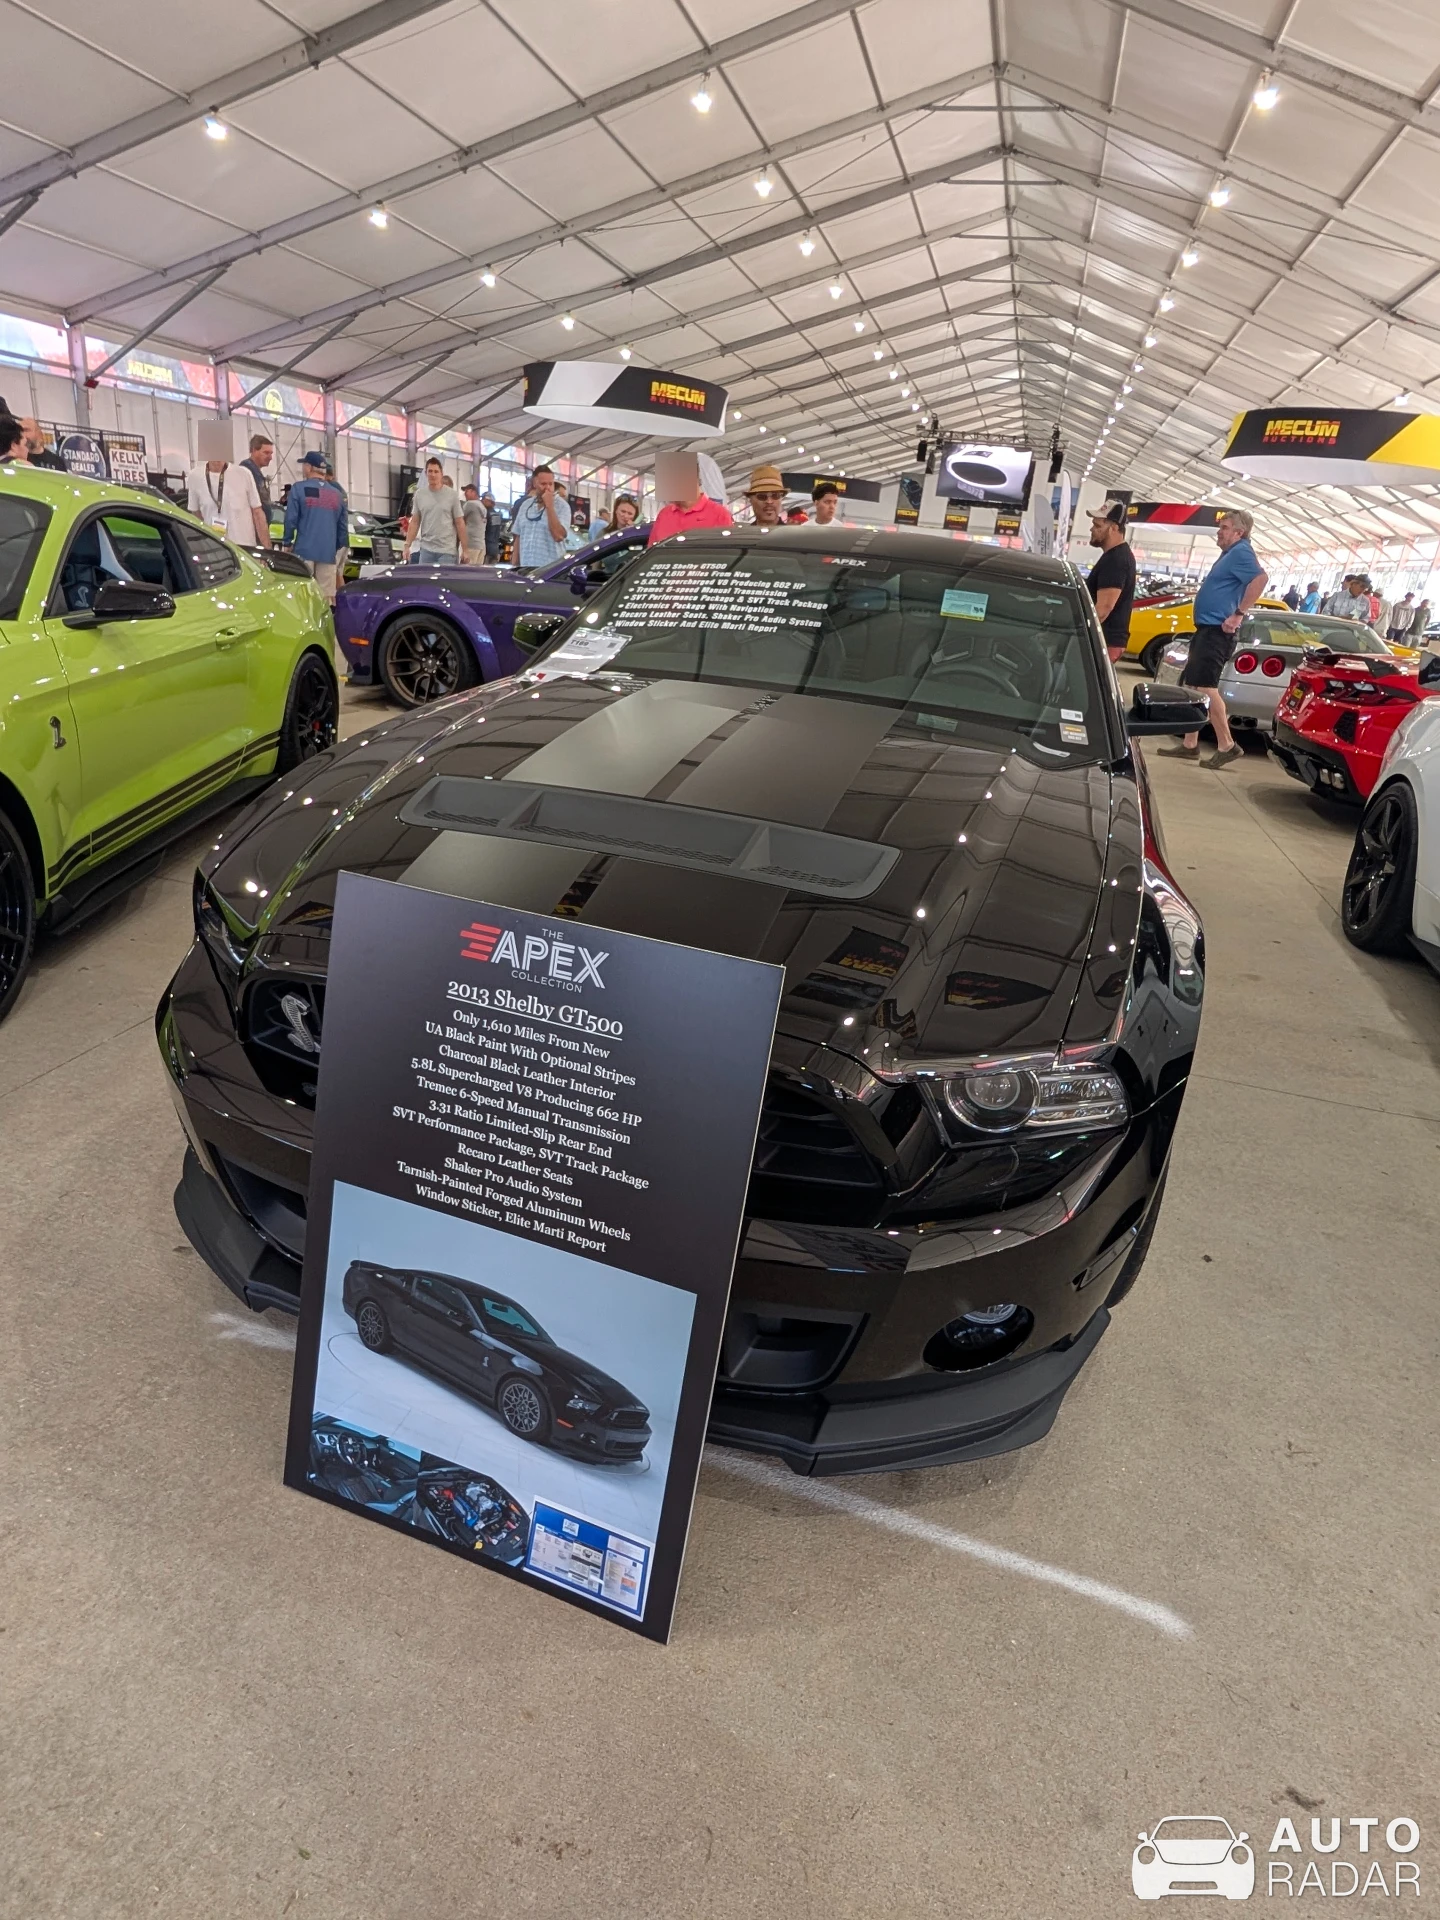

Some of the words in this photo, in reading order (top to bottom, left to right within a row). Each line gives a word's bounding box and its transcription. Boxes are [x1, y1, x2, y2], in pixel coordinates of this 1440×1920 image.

[651, 381, 705, 405] MECUM
[650, 396, 704, 411] AUCTIONS
[1265, 420, 1340, 436] MECUM
[1263, 436, 1336, 444] AUCTIONS
[64, 449, 100, 462] STANDARD
[112, 451, 143, 465] KELLY
[71, 462, 95, 473] DEALER
[114, 468, 145, 482] TIRES
[831, 558, 867, 566] APEX
[730, 579, 771, 588] Producing
[734, 588, 788, 597] Transmission
[700, 595, 734, 603] Package
[767, 598, 790, 606] Track
[792, 599, 828, 610] Package
[730, 604, 774, 613] Navigation
[712, 613, 742, 621] Shaker
[761, 616, 786, 624] Audio
[789, 617, 822, 627] System
[721, 622, 746, 630] Marti
[748, 624, 777, 633] Report
[542, 929, 564, 941] THE
[491, 930, 610, 989] APEX
[511, 970, 582, 993] COLLECTION
[447, 981, 490, 1005] 2013
[494, 989, 554, 1021] Shelby
[559, 1005, 623, 1035] GT500
[453, 1010, 480, 1028] Only
[483, 1019, 511, 1034] 1,610
[514, 1025, 545, 1043] Miles
[548, 1034, 580, 1052] From
[582, 1042, 610, 1059] New
[425, 1021, 443, 1036] UA
[445, 1026, 476, 1044] Black
[478, 1035, 507, 1052] Paint
[510, 1043, 538, 1061] With
[540, 1051, 591, 1074] Optional
[594, 1065, 636, 1086] Stripes
[439, 1044, 487, 1067] Charcoal
[490, 1057, 520, 1075] Black
[523, 1066, 567, 1087] Leather
[570, 1079, 616, 1100] Interior
[411, 1058, 436, 1072] 5.8L
[438, 1063, 513, 1093] Supercharged
[516, 1083, 532, 1097] V8
[535, 1089, 594, 1116] Producing
[597, 1105, 619, 1121] 662
[622, 1112, 642, 1127] HP
[416, 1075, 457, 1096] Tremec
[459, 1085, 504, 1109] 6-Speed
[506, 1101, 550, 1122] Manual
[552, 1112, 630, 1144] Transmission
[429, 1100, 452, 1114] 3.31
[454, 1105, 483, 1123] Ratio
[486, 1112, 556, 1143] Limited-Slip
[558, 1132, 586, 1151] Rear
[588, 1141, 612, 1159] End
[392, 1106, 416, 1121] SVT
[417, 1114, 485, 1141] Performance
[489, 1134, 536, 1158] Package,
[539, 1148, 563, 1163] SVT
[566, 1155, 599, 1174] Track
[601, 1167, 649, 1190] Package
[458, 1143, 495, 1163] Recaro
[498, 1155, 541, 1176] Leather
[543, 1168, 573, 1186] Seats
[444, 1157, 482, 1178] Shaker
[484, 1168, 504, 1183] Pro
[505, 1176, 539, 1195] Audio
[541, 1186, 582, 1208] System
[397, 1160, 483, 1195] Tarnish-Painted
[485, 1185, 523, 1208] Forged
[526, 1199, 586, 1227] Aluminum
[588, 1218, 631, 1241] Wheels
[416, 1184, 460, 1206] Window
[462, 1198, 503, 1221] Sticker,
[505, 1212, 531, 1229] Elite
[533, 1220, 565, 1239] Marti
[567, 1231, 606, 1253] Report
